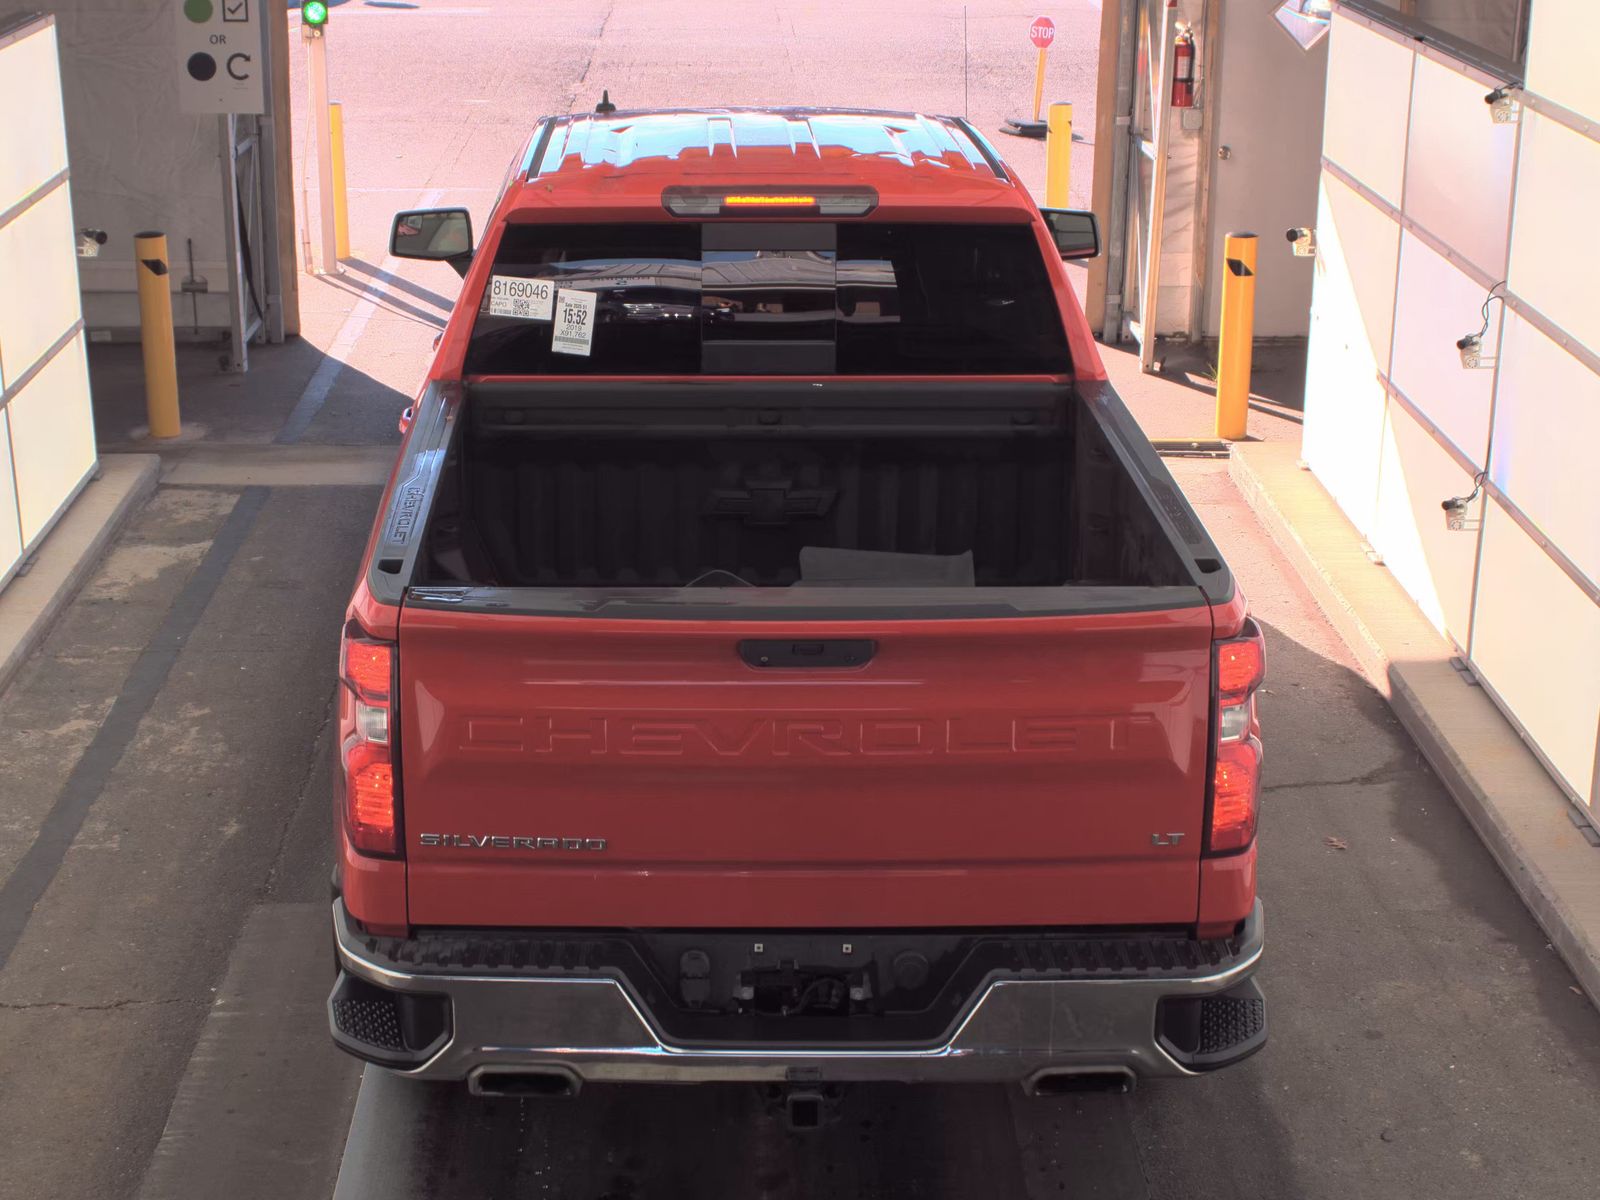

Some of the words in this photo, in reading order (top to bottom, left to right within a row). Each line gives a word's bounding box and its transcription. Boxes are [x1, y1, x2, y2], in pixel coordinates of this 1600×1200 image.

[209, 34, 227, 45] OR
[1031, 26, 1054, 38] STOP
[494, 280, 548, 299] 8169046
[563, 308, 587, 325] 15:52
[391, 487, 425, 545] CHEVROLET
[457, 712, 1154, 757] CHEVROLET
[419, 832, 607, 850] SILVERADO
[1152, 832, 1185, 846] LT
